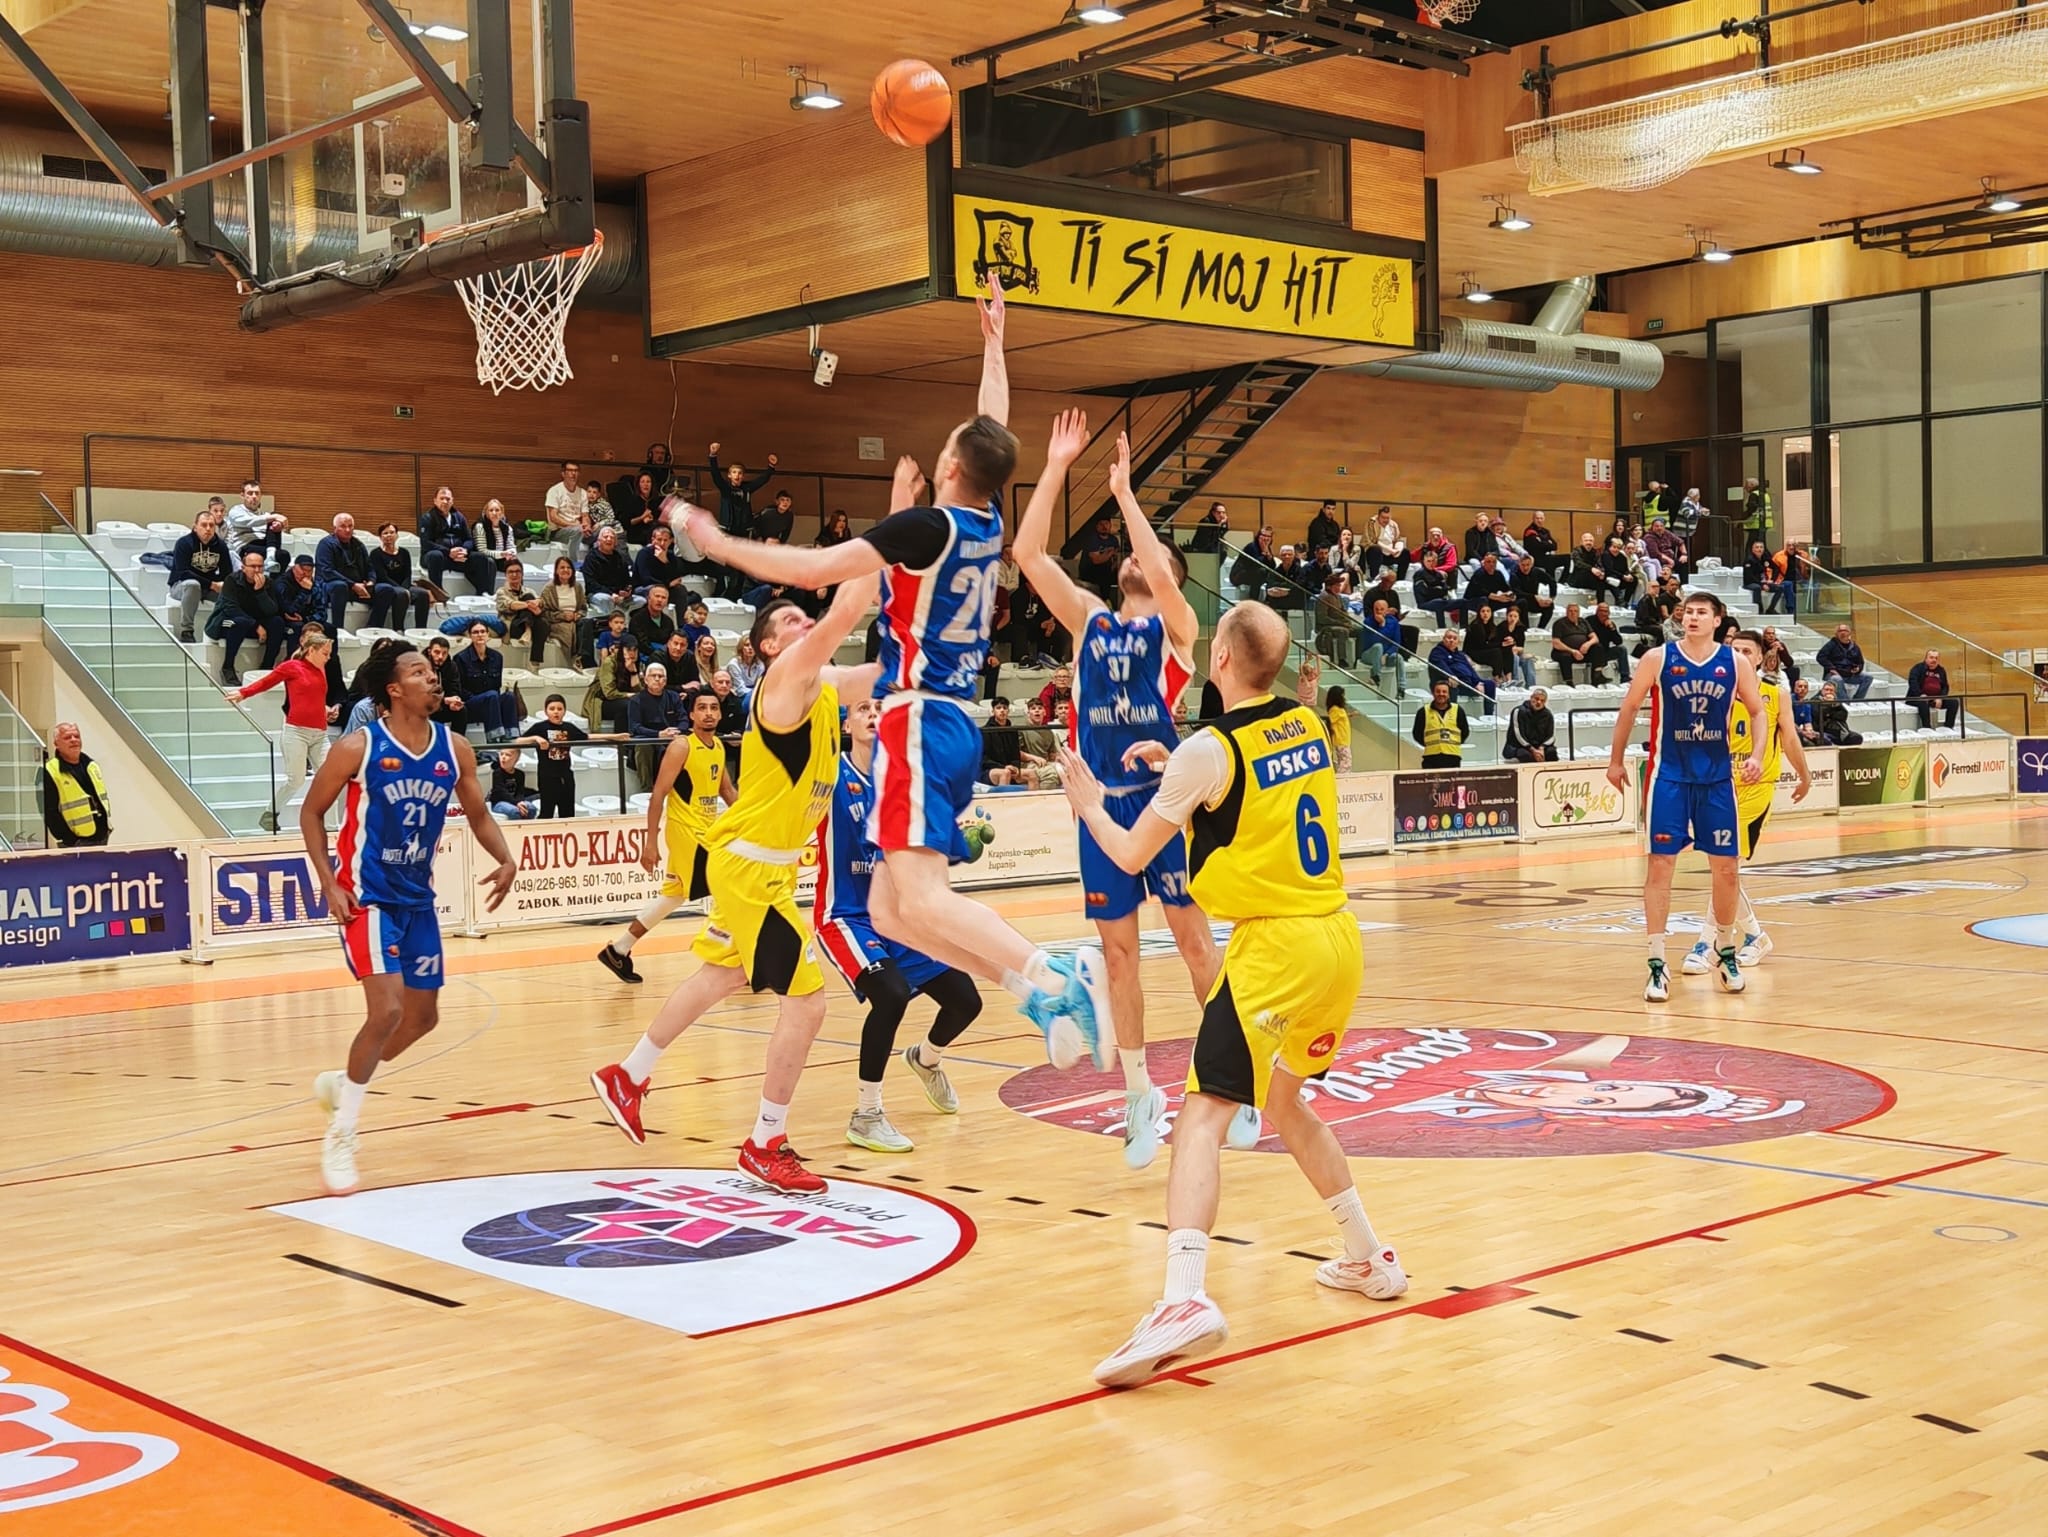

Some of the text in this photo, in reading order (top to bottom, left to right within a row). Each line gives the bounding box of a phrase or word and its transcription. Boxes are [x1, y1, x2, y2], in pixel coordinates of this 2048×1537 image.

[1180, 246, 1266, 313] MOJ
[1671, 680, 1726, 700] ALKAR
[1688, 696, 1708, 714] 12
[1735, 720, 1746, 737] 4
[1267, 749, 1309, 782] PSK
[1951, 760, 2006, 775] Ferrostil MONT
[382, 778, 448, 807] ALKAR
[1342, 792, 1384, 804] HRVATSKA
[1543, 777, 1591, 805] Kuna
[402, 802, 427, 827] 21
[1296, 793, 1330, 877] 6
[1713, 829, 1732, 847] 12
[582, 871, 626, 890] 501-700,
[628, 870, 645, 884] Fax
[66, 872, 165, 928] print
[566, 895, 604, 907] Matije
[606, 892, 642, 903] Gupca
[413, 953, 440, 977] 21
[592, 1177, 924, 1249] FAVBET
